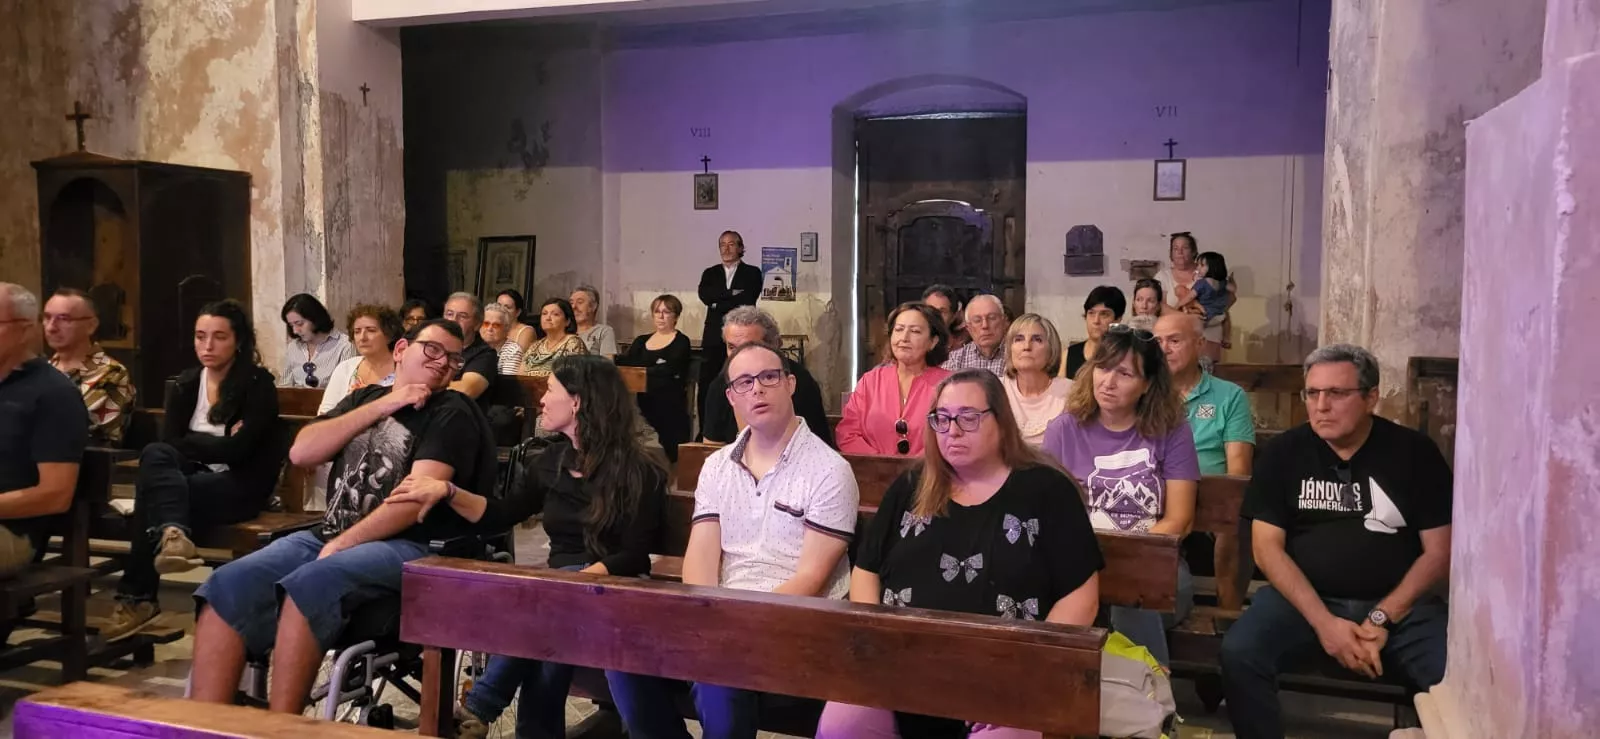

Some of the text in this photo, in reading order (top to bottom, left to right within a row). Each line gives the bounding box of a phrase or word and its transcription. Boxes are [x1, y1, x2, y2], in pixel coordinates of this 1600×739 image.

[1154, 105, 1178, 118] VII
[689, 126, 711, 138] VIII
[1298, 476, 1361, 502] JÁNOVS
[1298, 499, 1363, 512] INSUMERGE
